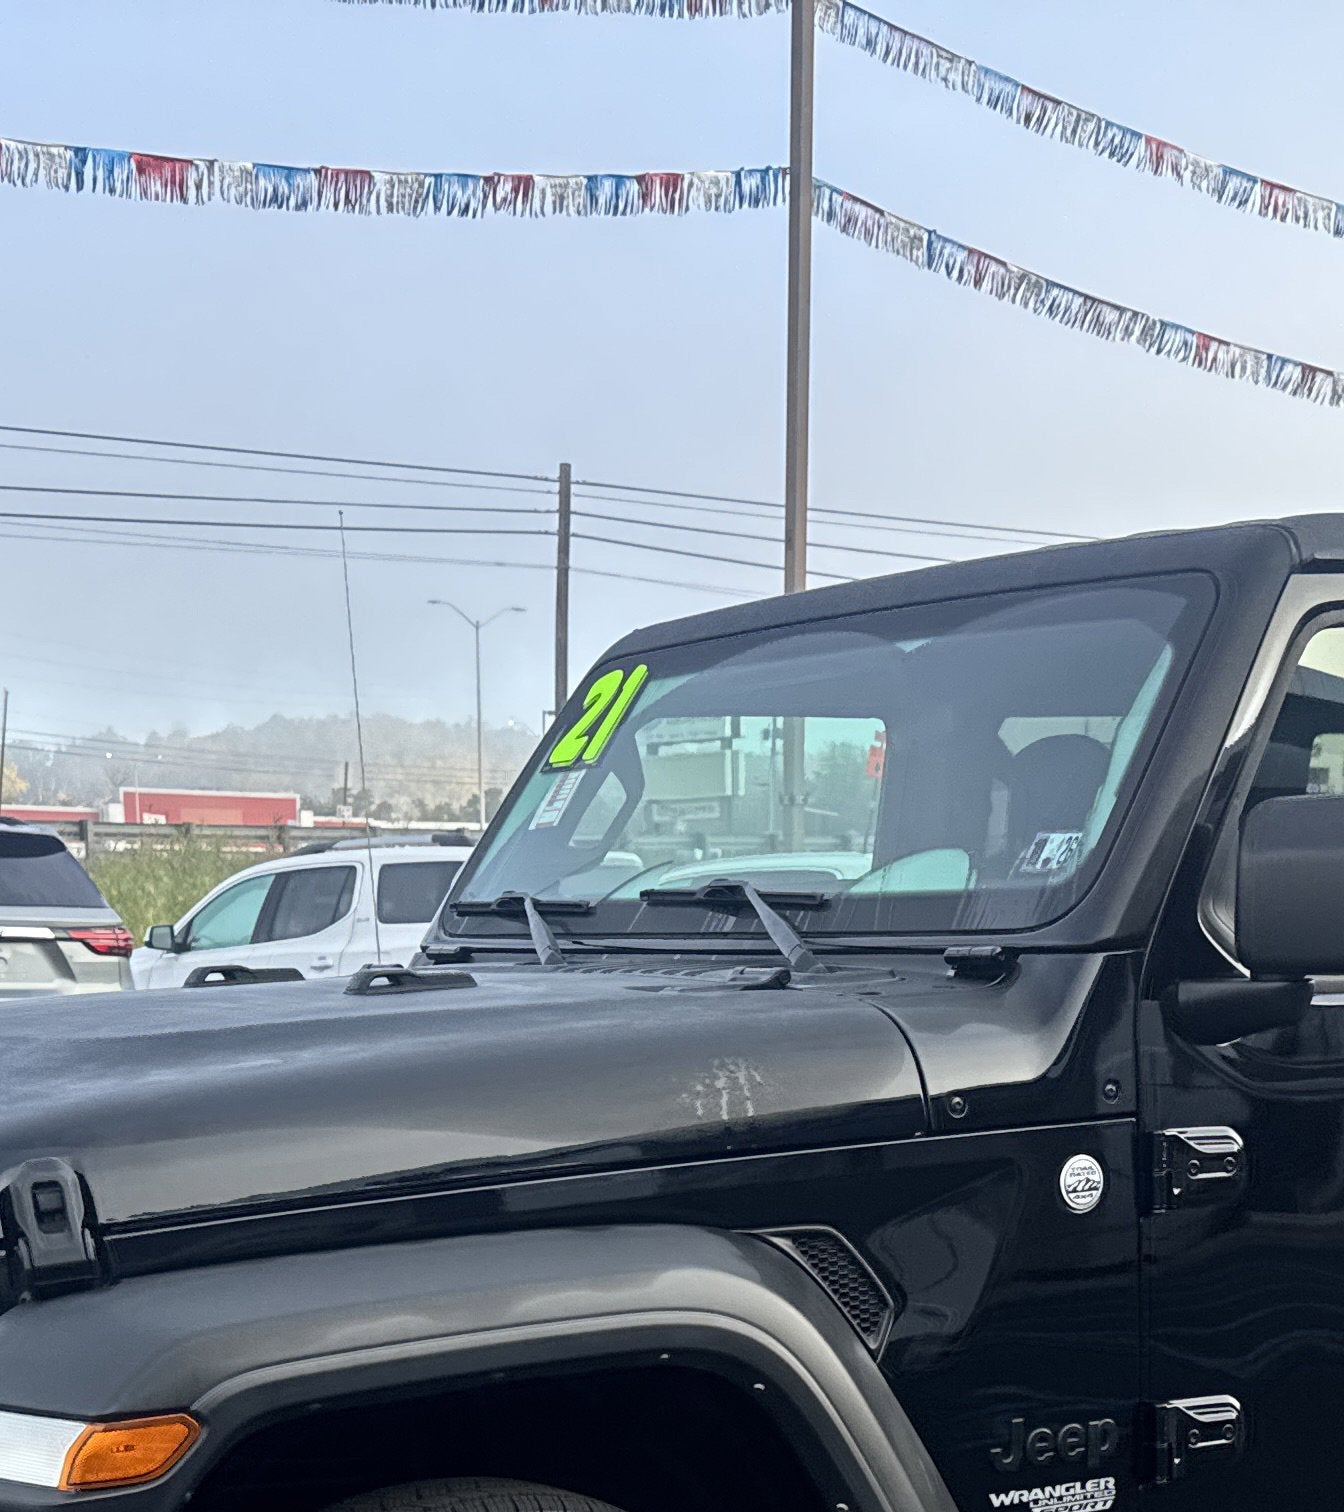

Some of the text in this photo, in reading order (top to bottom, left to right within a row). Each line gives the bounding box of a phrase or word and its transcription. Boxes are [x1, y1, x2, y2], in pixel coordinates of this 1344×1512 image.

[549, 664, 649, 768] 21
[989, 1417, 1119, 1472] Jeep
[989, 1476, 1116, 1508] WRANGLER
[1029, 1489, 1117, 1509] UNLIMITED
